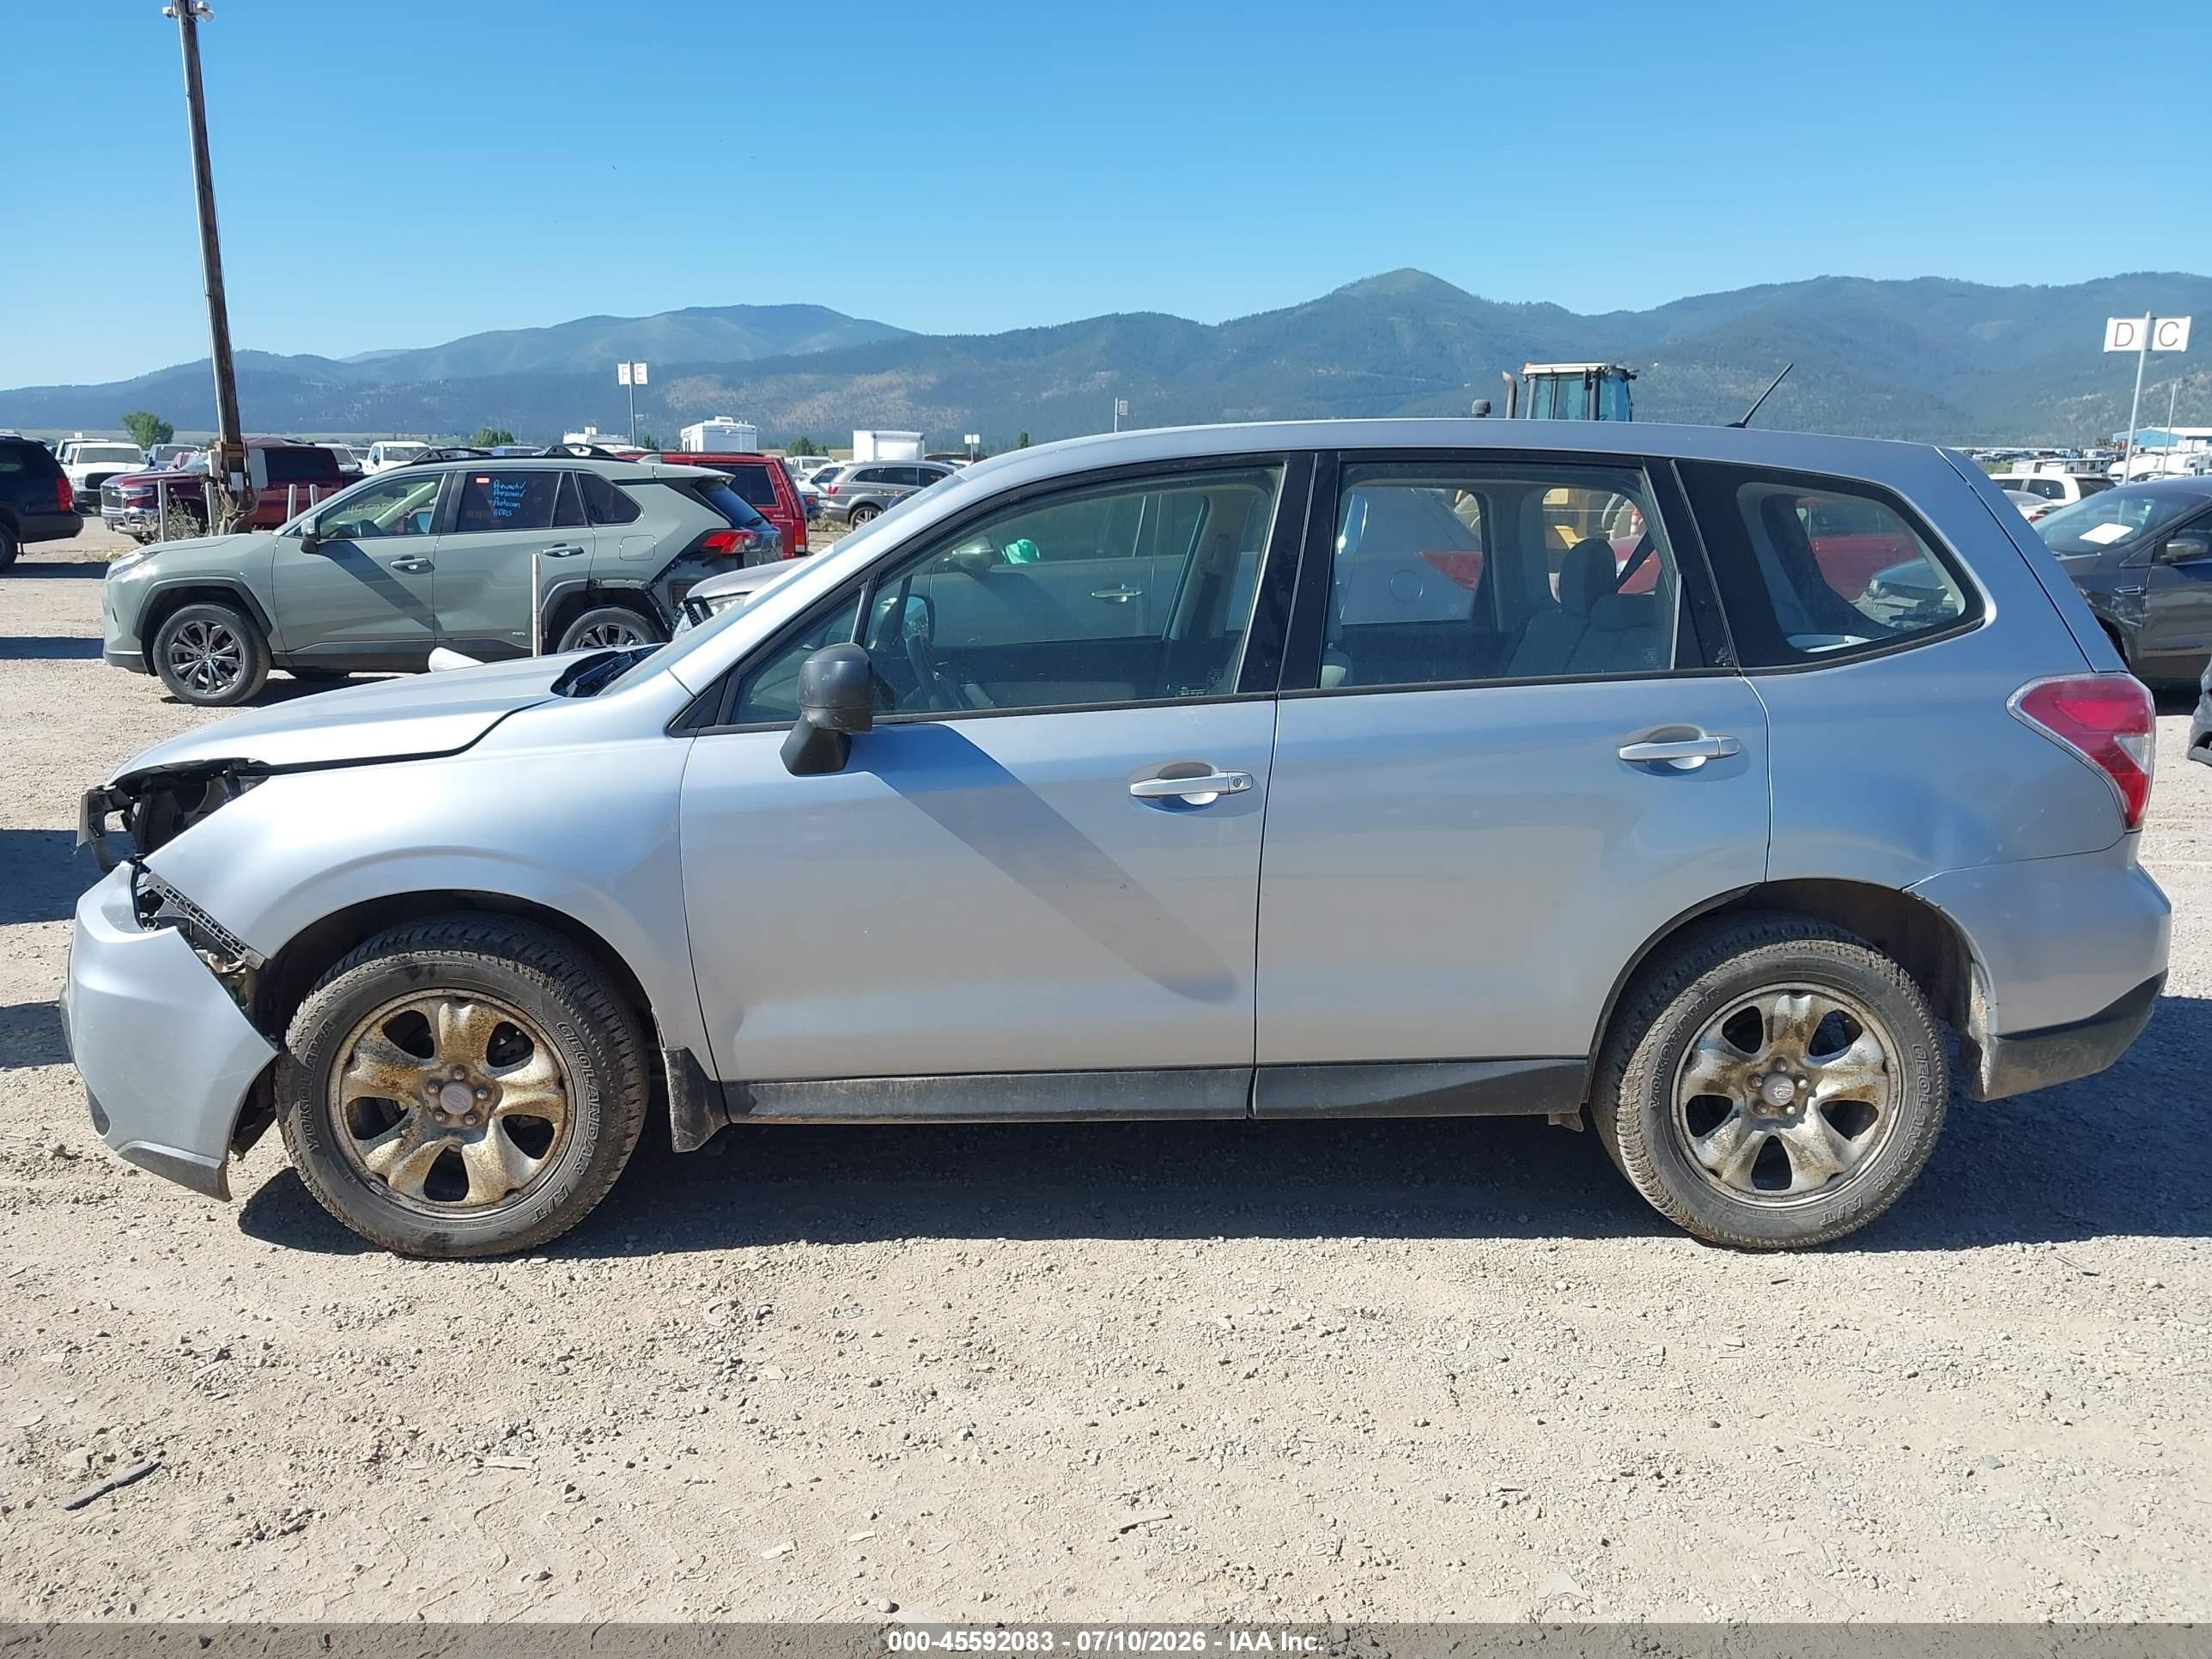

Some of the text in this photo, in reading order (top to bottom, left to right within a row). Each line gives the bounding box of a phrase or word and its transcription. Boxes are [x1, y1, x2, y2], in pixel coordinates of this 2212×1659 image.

[2114, 322, 2135, 347] D
[2158, 320, 2180, 348] C
[622, 366, 629, 385] F
[636, 365, 644, 382] E
[556, 1021, 600, 1176] GEOLANDAR
[1874, 1043, 1930, 1193] GEOLANDAR
[532, 1182, 570, 1224] A/T
